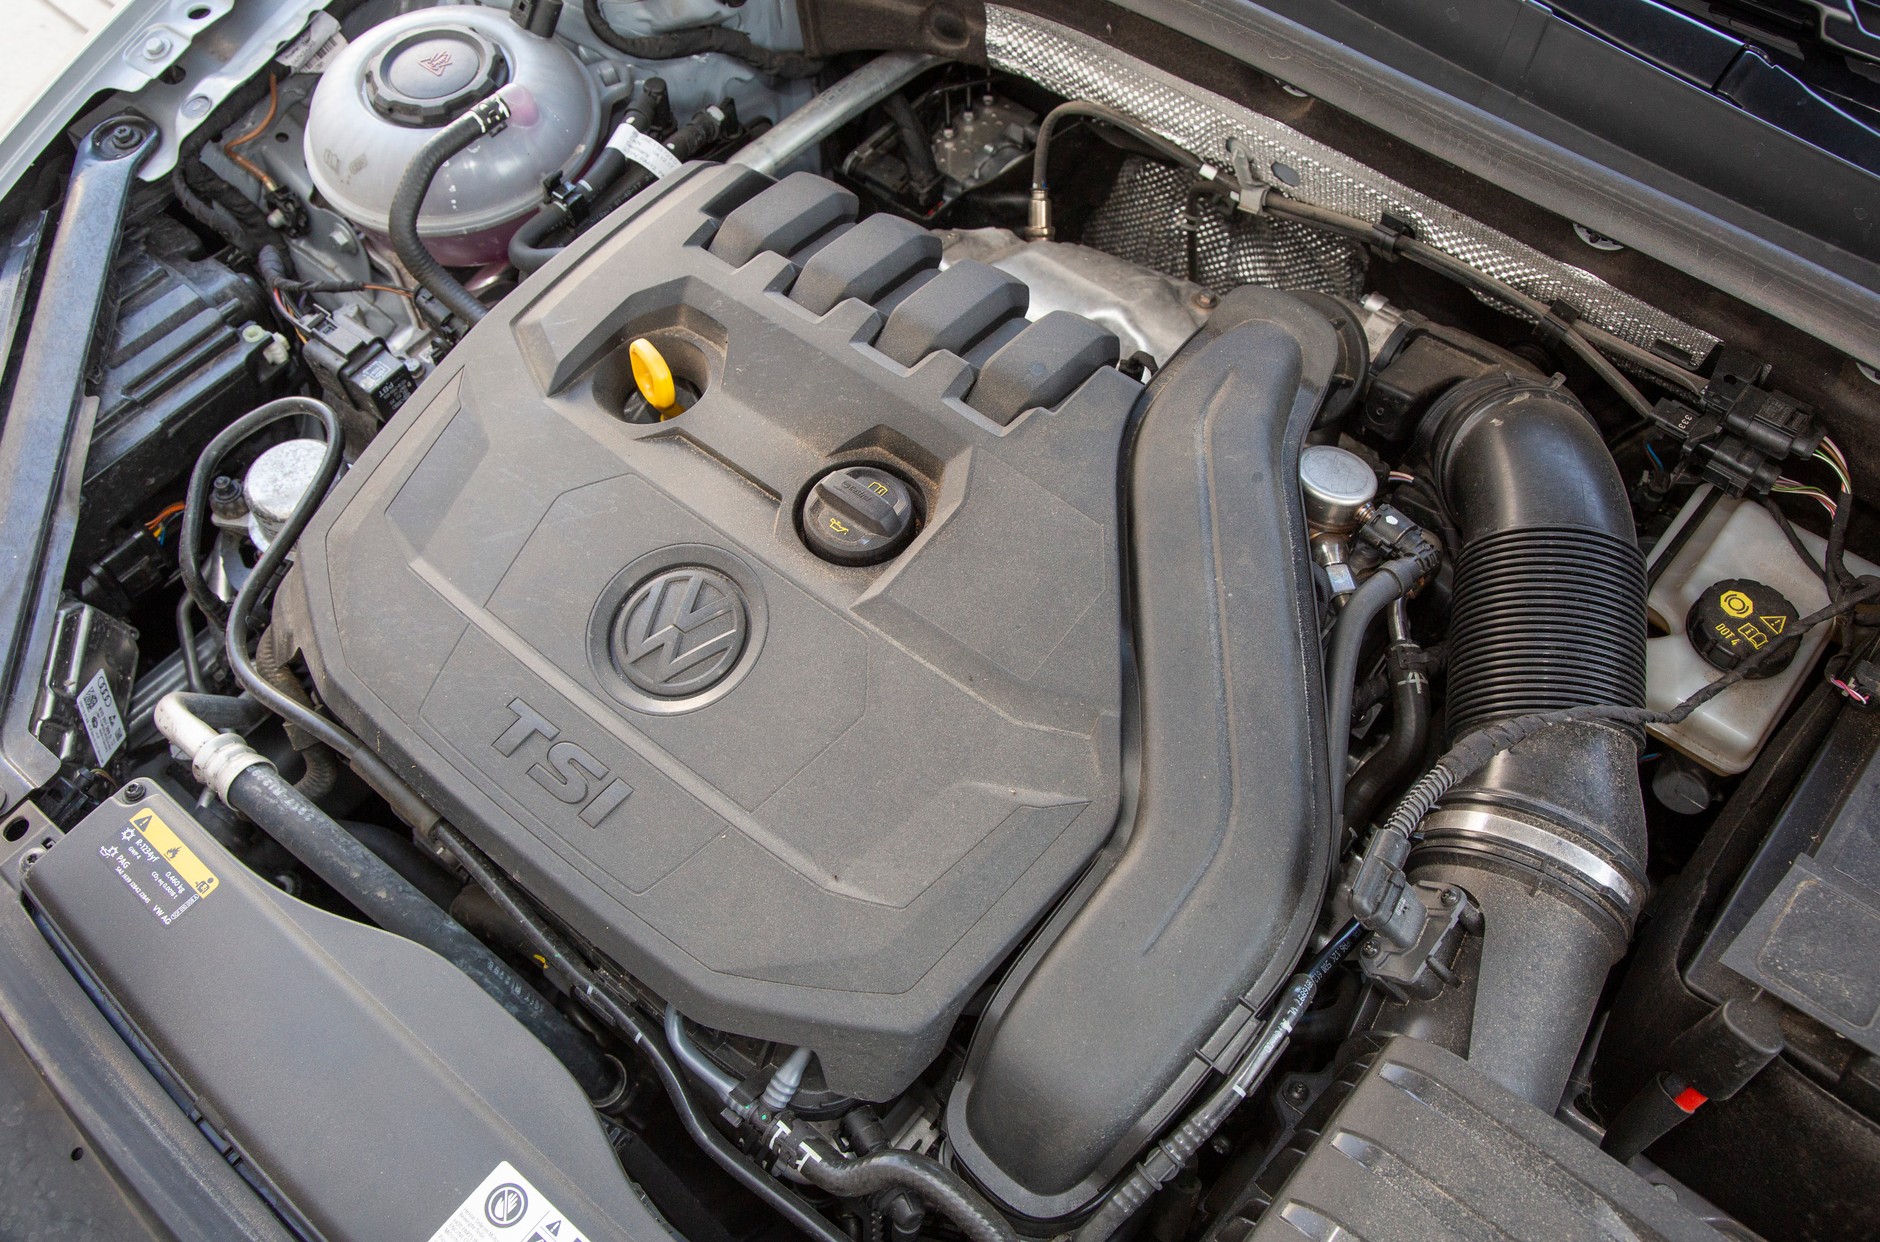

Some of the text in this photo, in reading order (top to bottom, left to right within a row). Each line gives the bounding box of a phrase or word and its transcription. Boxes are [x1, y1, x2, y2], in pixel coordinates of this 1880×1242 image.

[1715, 623, 1740, 647] DOT 4
[491, 696, 636, 829] TSI
[115, 854, 130, 869] PAG
[135, 838, 160, 863] R-1234yf
[114, 865, 124, 875] SAE
[165, 870, 180, 887] 0.460
[177, 883, 186, 894] kg
[152, 904, 172, 926] VW AG
